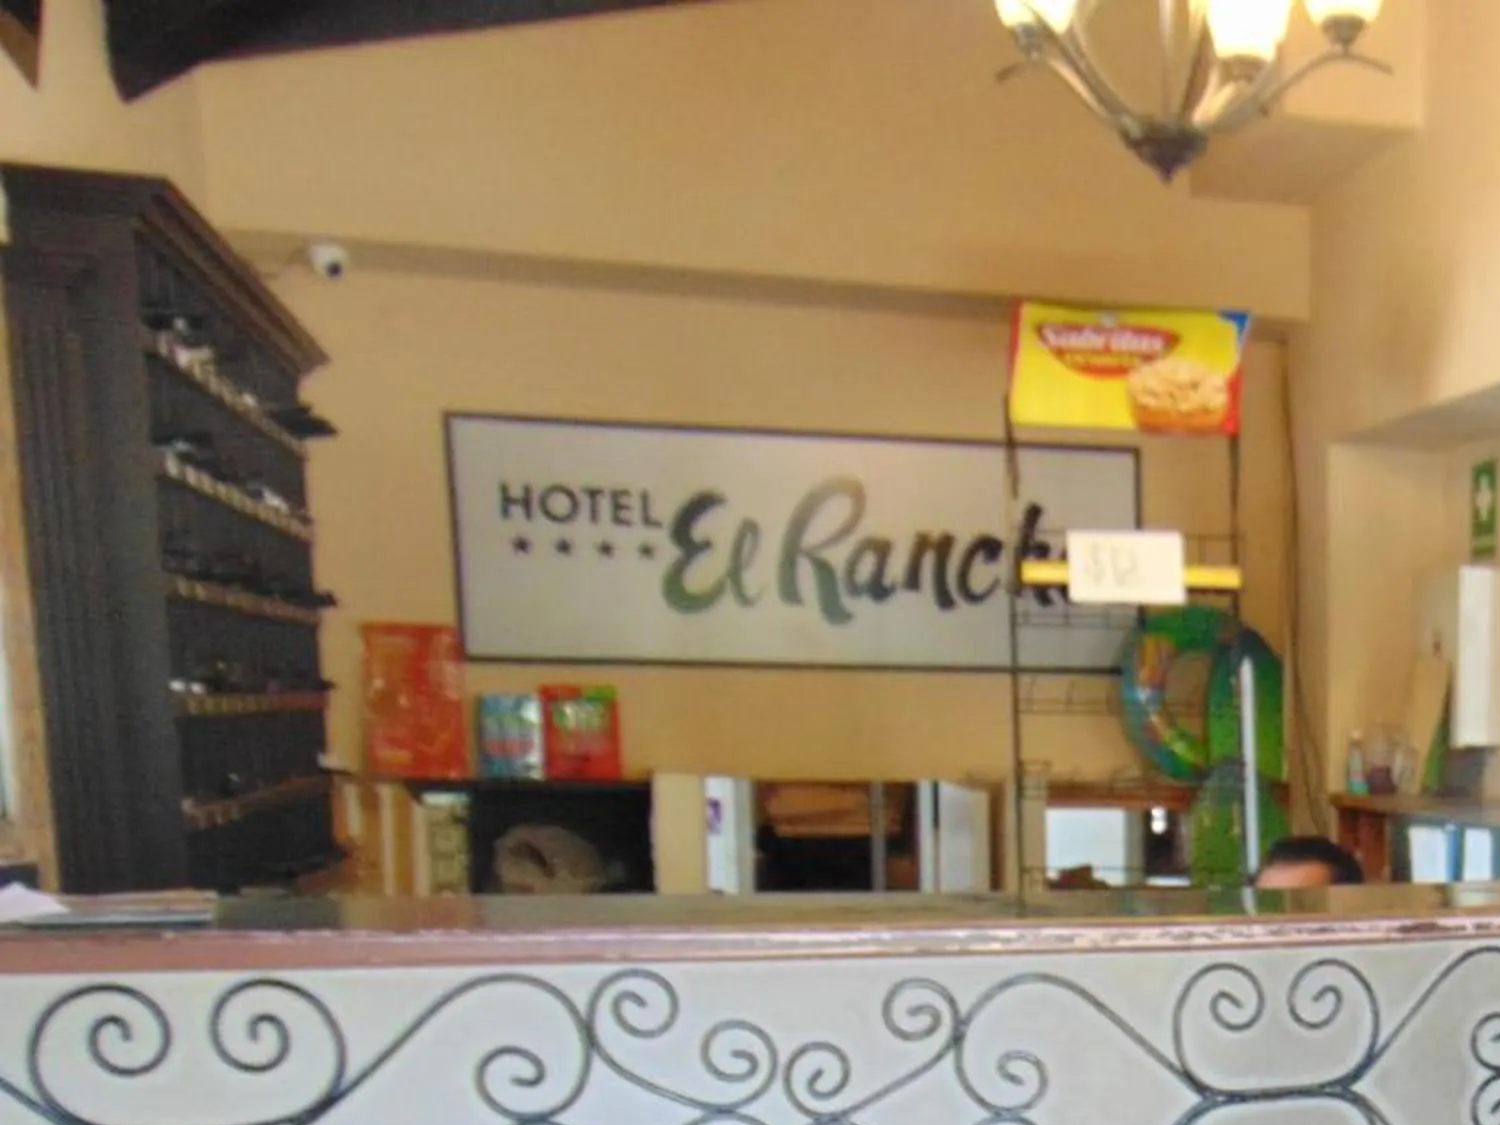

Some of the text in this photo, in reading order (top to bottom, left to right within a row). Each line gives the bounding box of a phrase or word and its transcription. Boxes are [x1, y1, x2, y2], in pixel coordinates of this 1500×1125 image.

[499, 482, 662, 528] HOTEL
[662, 475, 1070, 625] El Ranch
